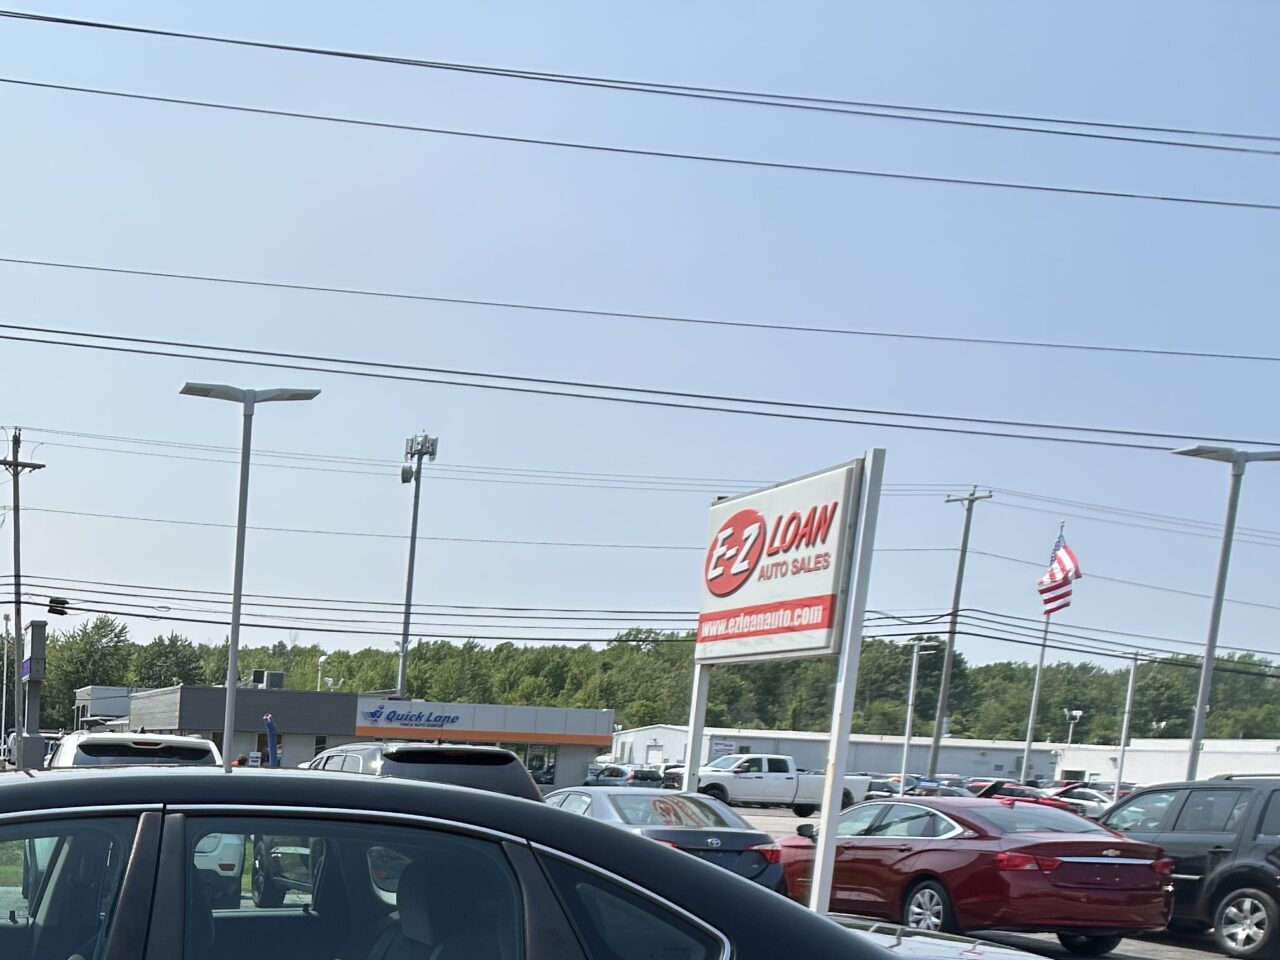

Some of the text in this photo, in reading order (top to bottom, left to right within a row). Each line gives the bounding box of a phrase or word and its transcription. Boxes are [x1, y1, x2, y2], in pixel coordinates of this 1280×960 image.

[707, 501, 839, 582] E-Z LOAN
[757, 552, 831, 582] AUTO SALES
[701, 604, 823, 638] www.ezloanauto.com
[386, 710, 460, 724] Quick Lane
